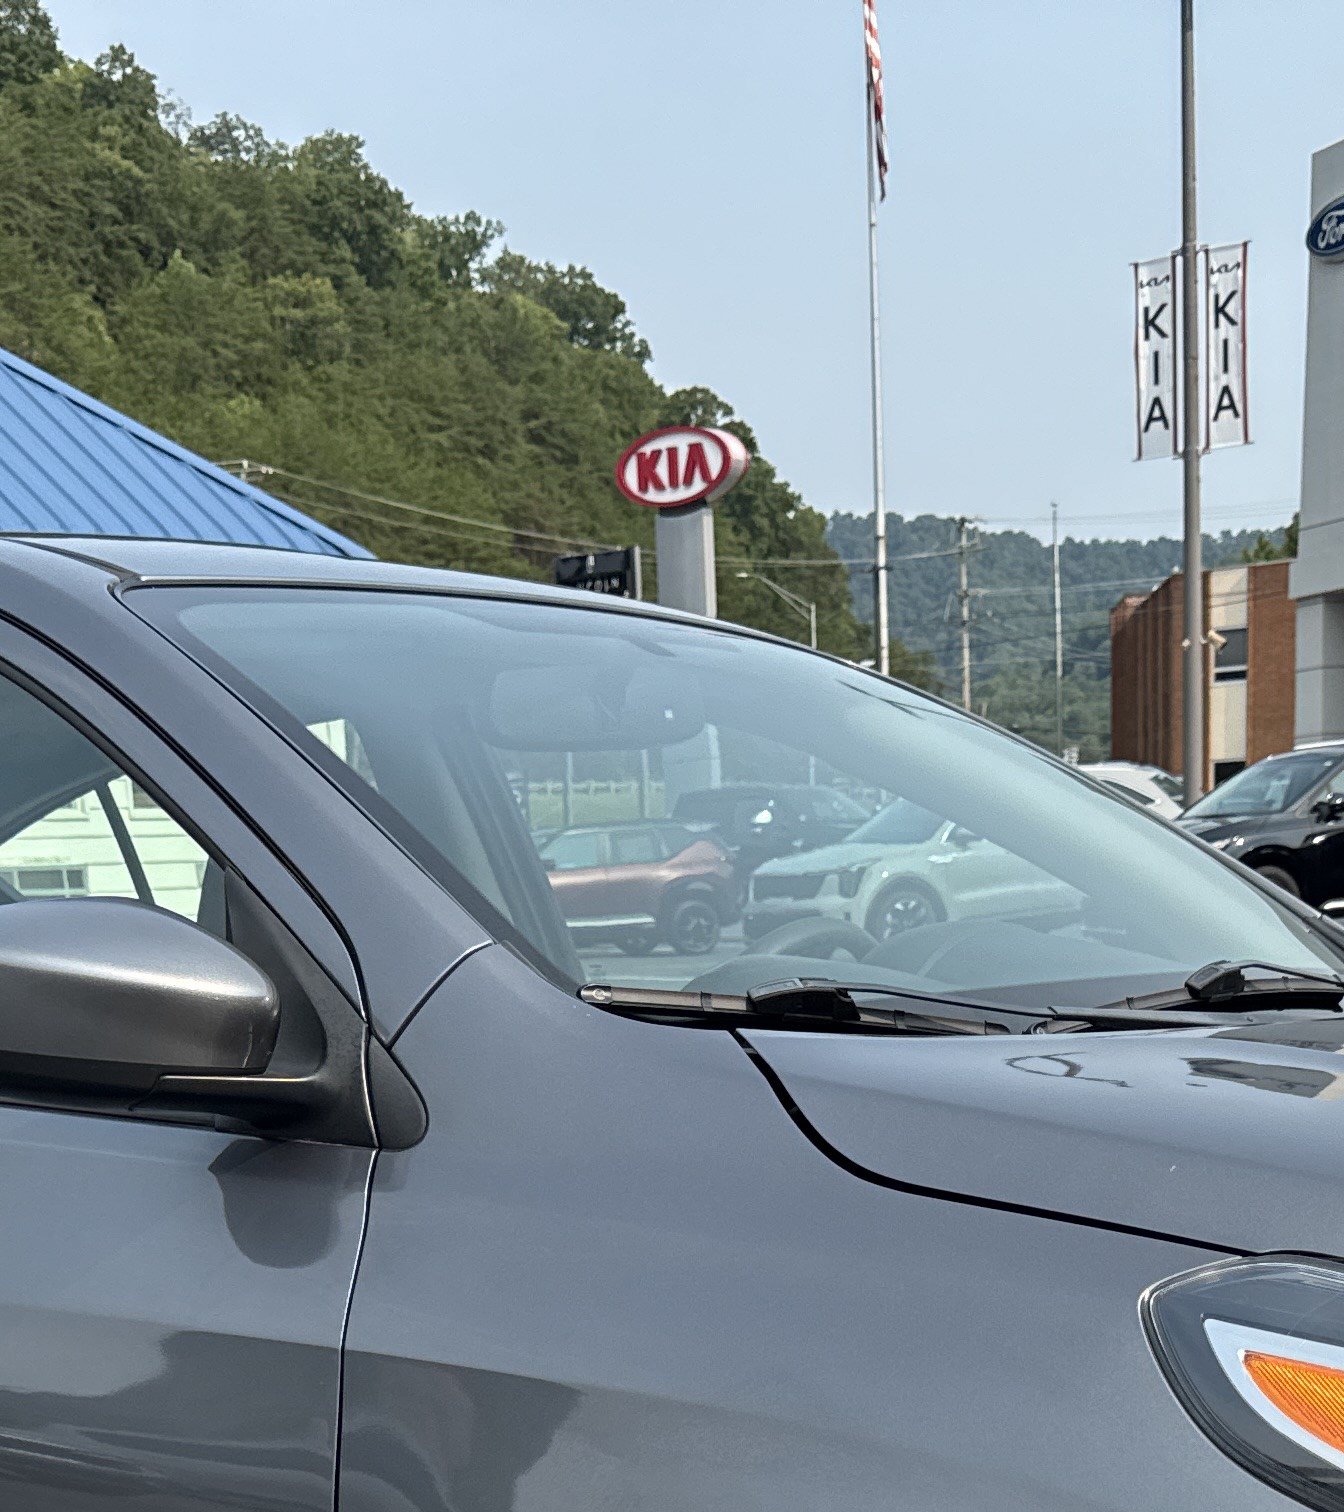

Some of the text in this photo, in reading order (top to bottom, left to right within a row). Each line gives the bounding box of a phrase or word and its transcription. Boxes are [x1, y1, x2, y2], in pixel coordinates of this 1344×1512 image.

[1142, 302, 1170, 433] KIA
[1212, 289, 1240, 422] KIA
[636, 441, 713, 494] KIA
